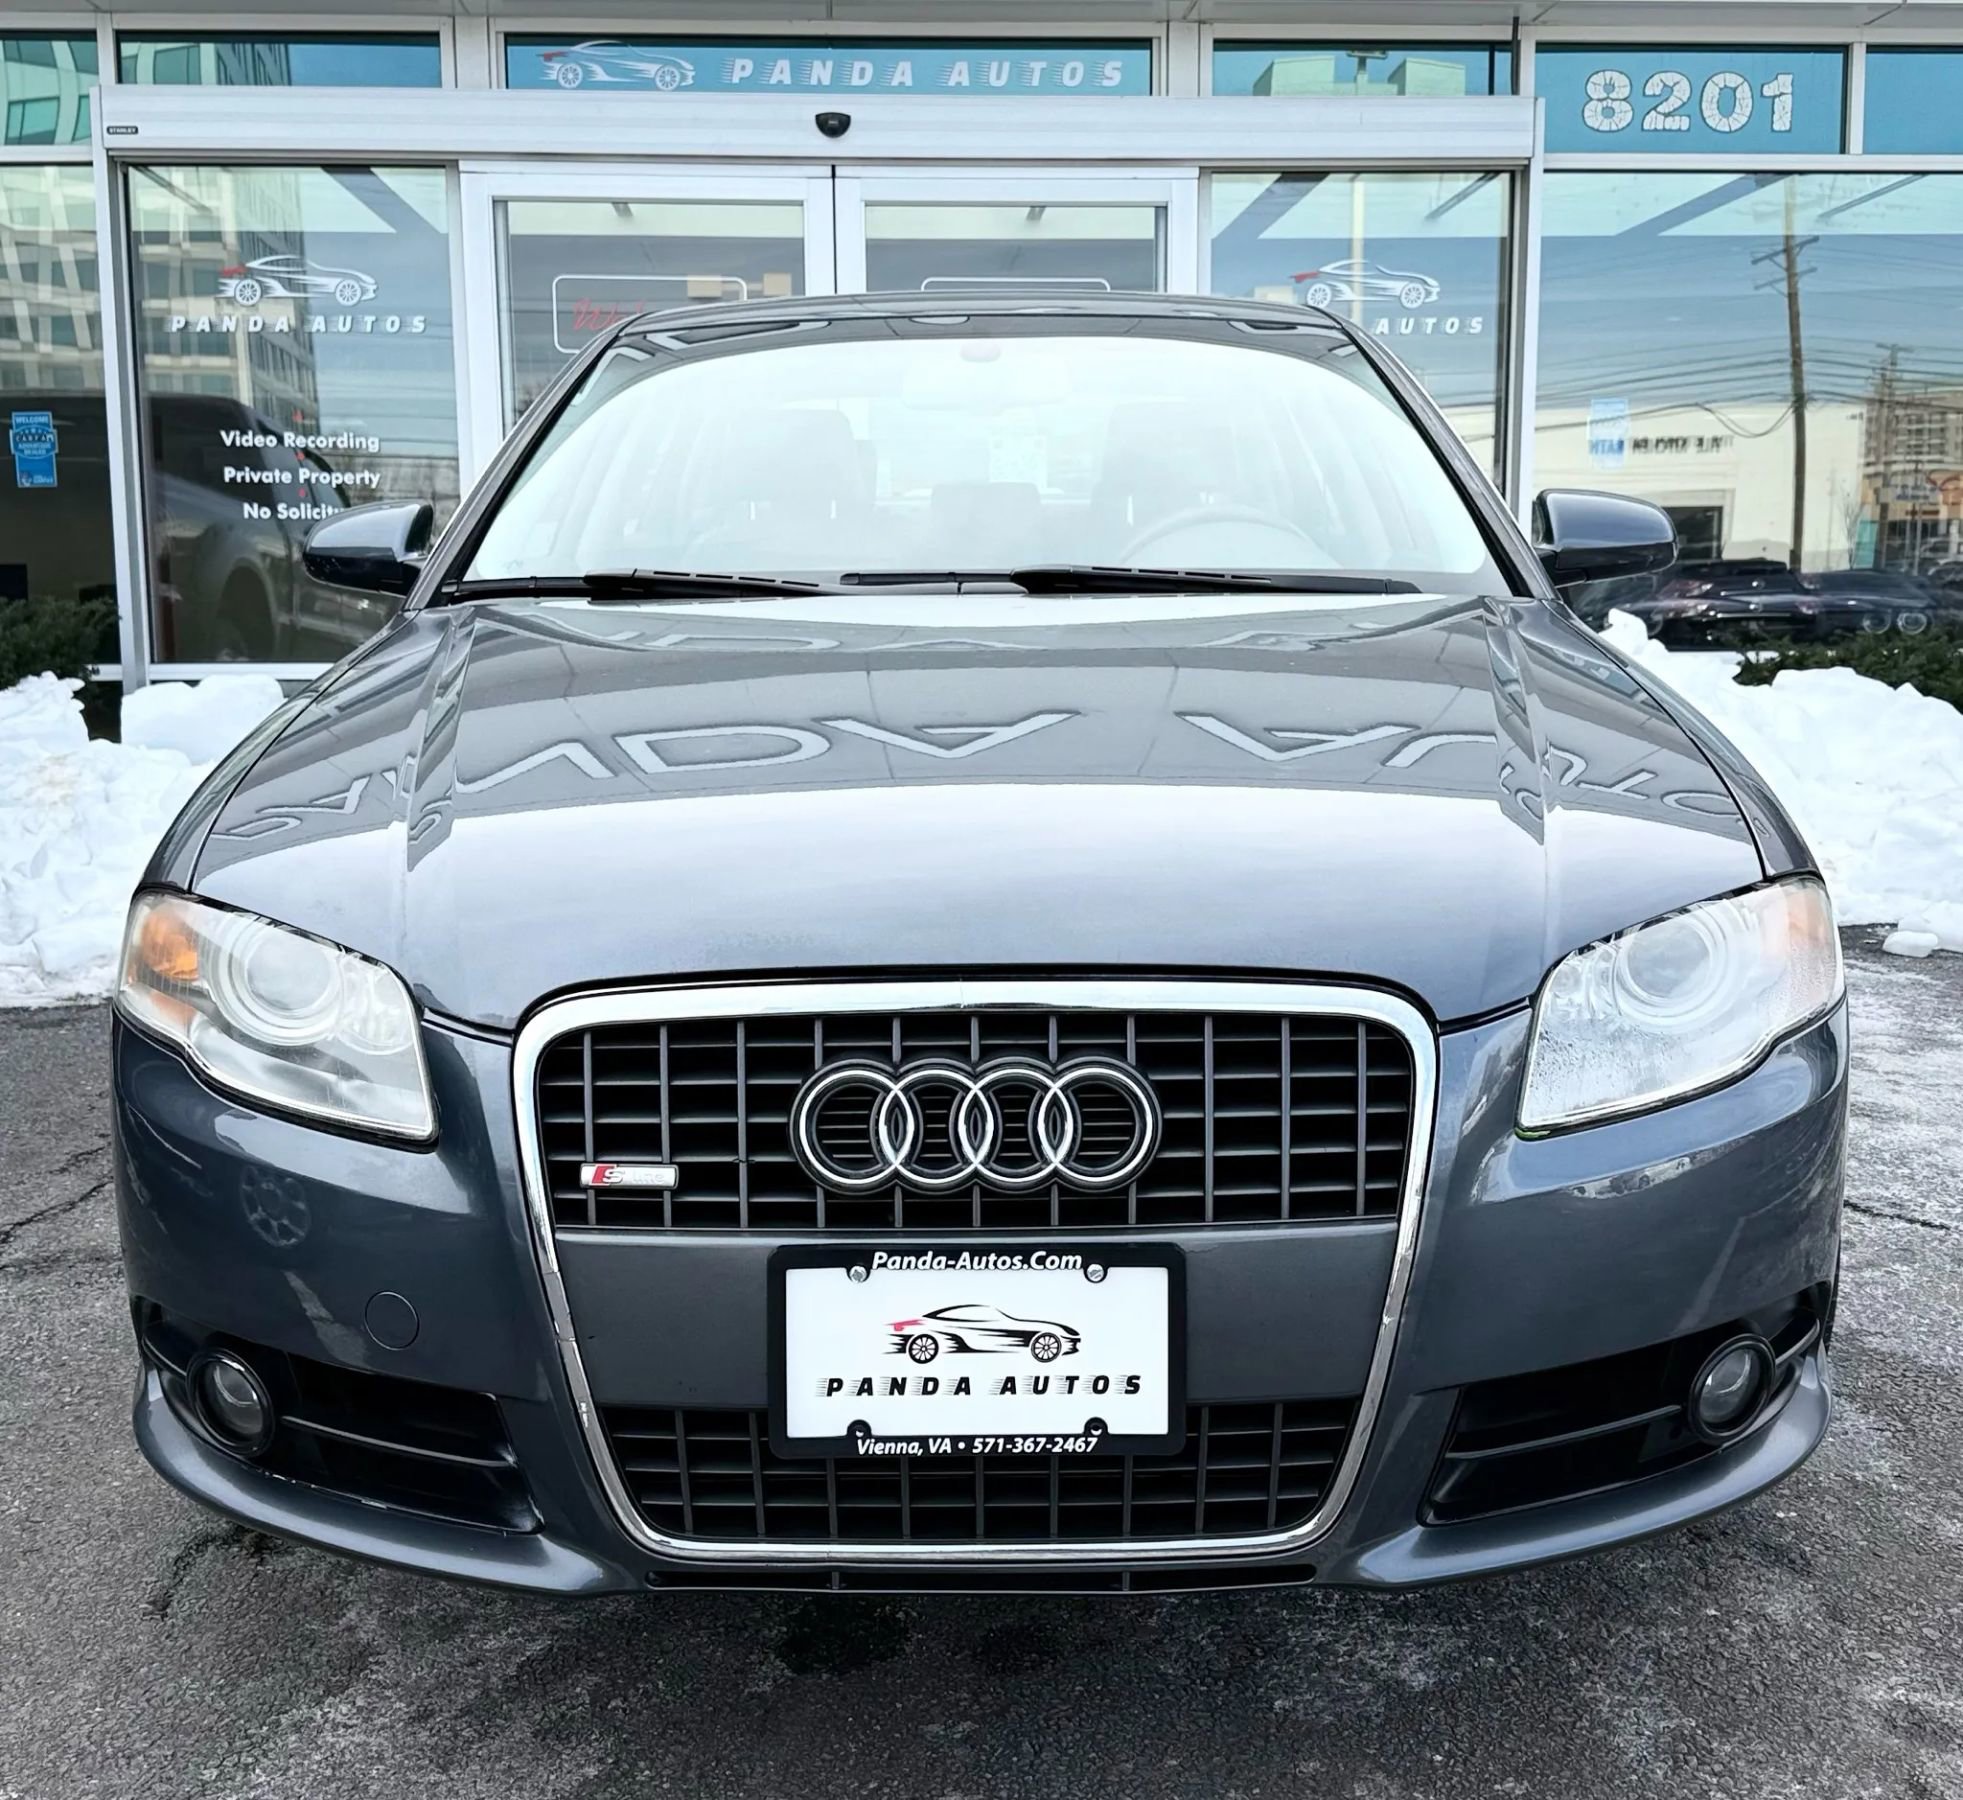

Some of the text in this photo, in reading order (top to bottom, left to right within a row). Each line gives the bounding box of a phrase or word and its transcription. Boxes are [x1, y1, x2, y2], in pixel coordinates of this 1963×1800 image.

[728, 57, 1123, 88] PANDA AUTOS
[1582, 69, 1794, 133] 8201
[169, 315, 426, 333] PANDA AUTOS
[1374, 316, 1484, 335] AUTOS
[220, 429, 380, 452] Video Recording
[223, 466, 381, 489] Private Property
[243, 503, 272, 519] No
[871, 1250, 1083, 1271] Panda-Autos.Com
[825, 1374, 1142, 1397] PANDA AUTOS
[856, 1437, 1099, 1457] Vienna, VA 571-367-2467
